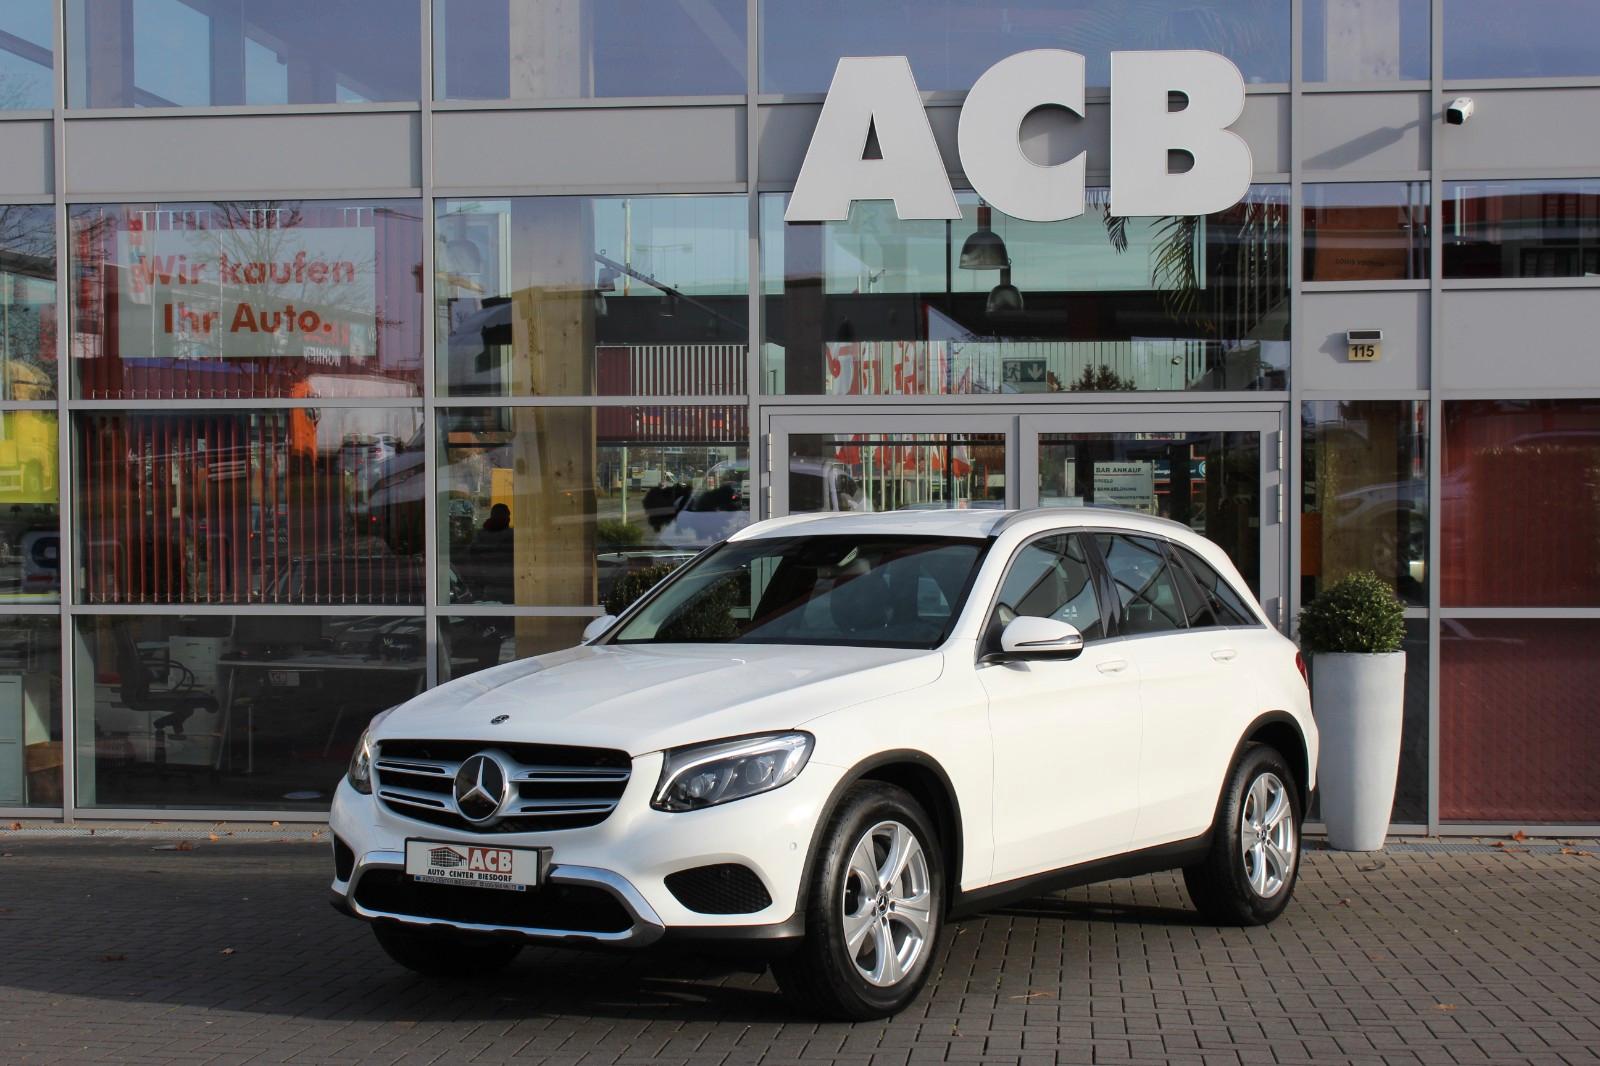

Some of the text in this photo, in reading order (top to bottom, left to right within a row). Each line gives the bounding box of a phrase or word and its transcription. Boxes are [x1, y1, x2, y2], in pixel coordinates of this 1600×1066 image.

[784, 48, 1253, 222] ACB
[138, 255, 207, 285] Wir
[220, 251, 355, 285] kaufen
[164, 302, 332, 334] Ihr Auto.
[1351, 345, 1375, 358] 115
[469, 848, 512, 872] ACB
[427, 868, 512, 882] AUTO CENTER BIESDORF
